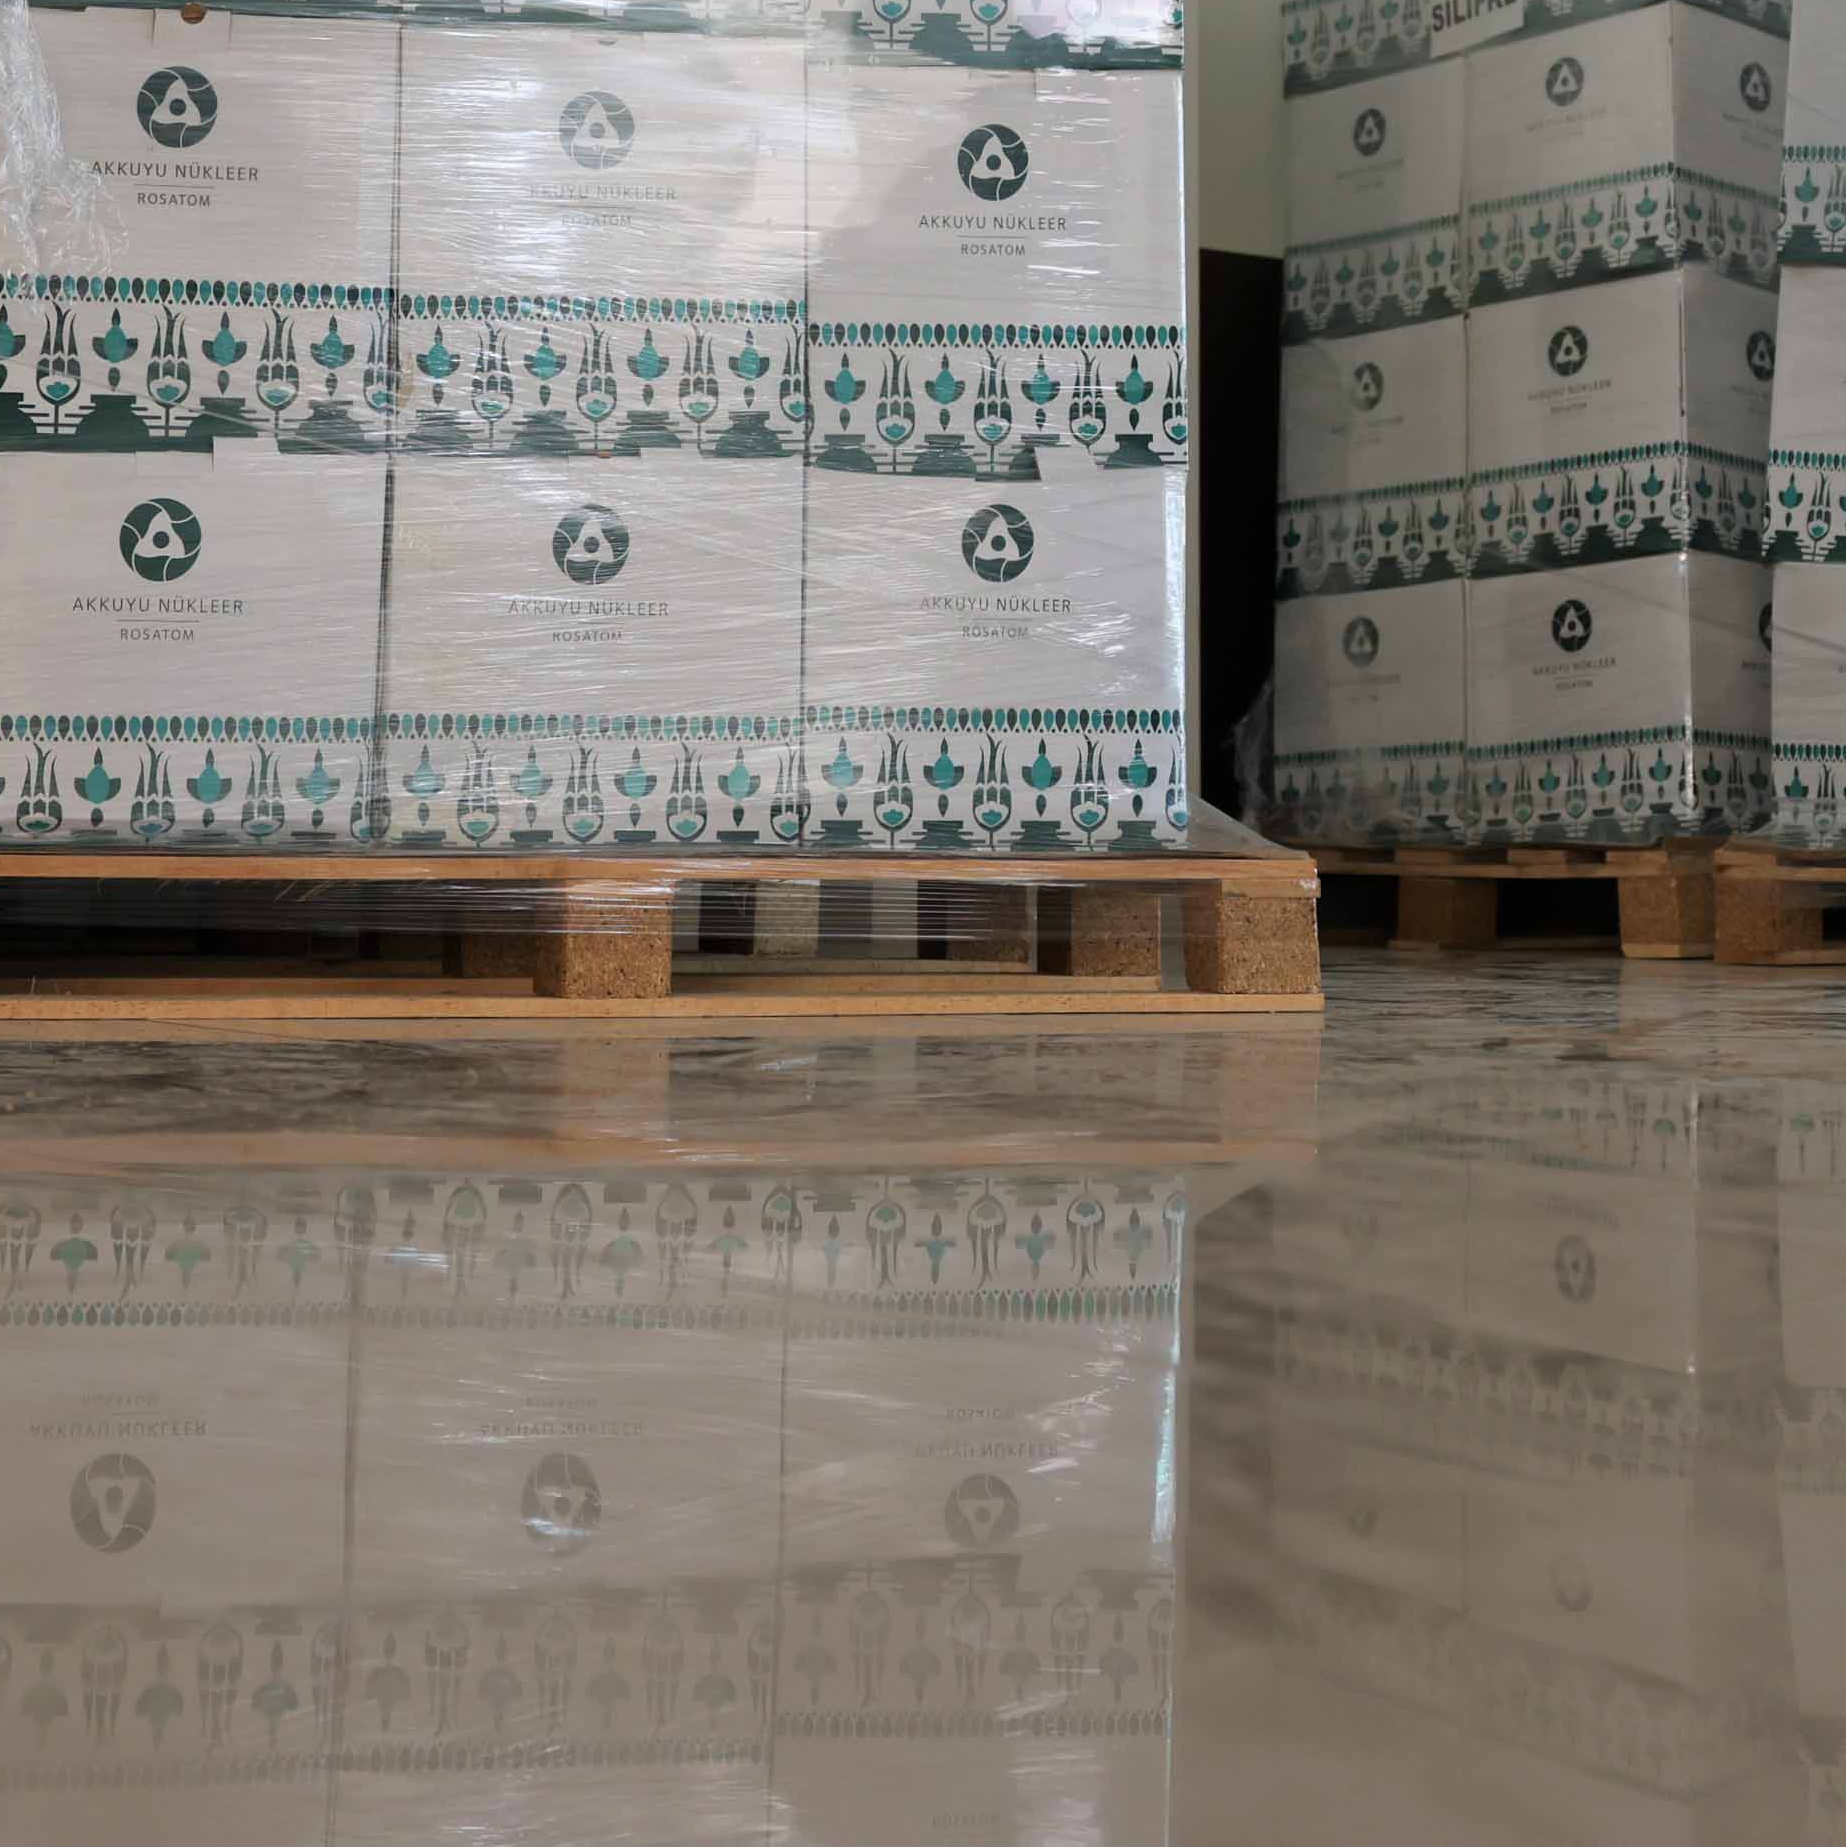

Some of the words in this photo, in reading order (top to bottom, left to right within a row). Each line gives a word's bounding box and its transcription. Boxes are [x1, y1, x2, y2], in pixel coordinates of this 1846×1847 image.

[91, 160, 167, 178] AKKUYU
[175, 160, 258, 181] NÜKLEER
[136, 192, 211, 207] ROSATOM
[521, 185, 590, 200] KKUYU
[918, 214, 986, 230] AKKUYU
[992, 212, 1067, 231] NÜKLEER
[960, 242, 1026, 257] ROSATOM
[72, 596, 151, 613] AKKUYU
[158, 595, 243, 615] NÜKLEER
[508, 600, 581, 616] AKKUYU
[588, 599, 669, 617] NÜKLEER
[920, 596, 989, 612] AKKUYU
[995, 594, 1071, 613] NÜKLEER
[119, 627, 194, 641] ROSATOM
[961, 625, 1028, 639] ROSATOM
